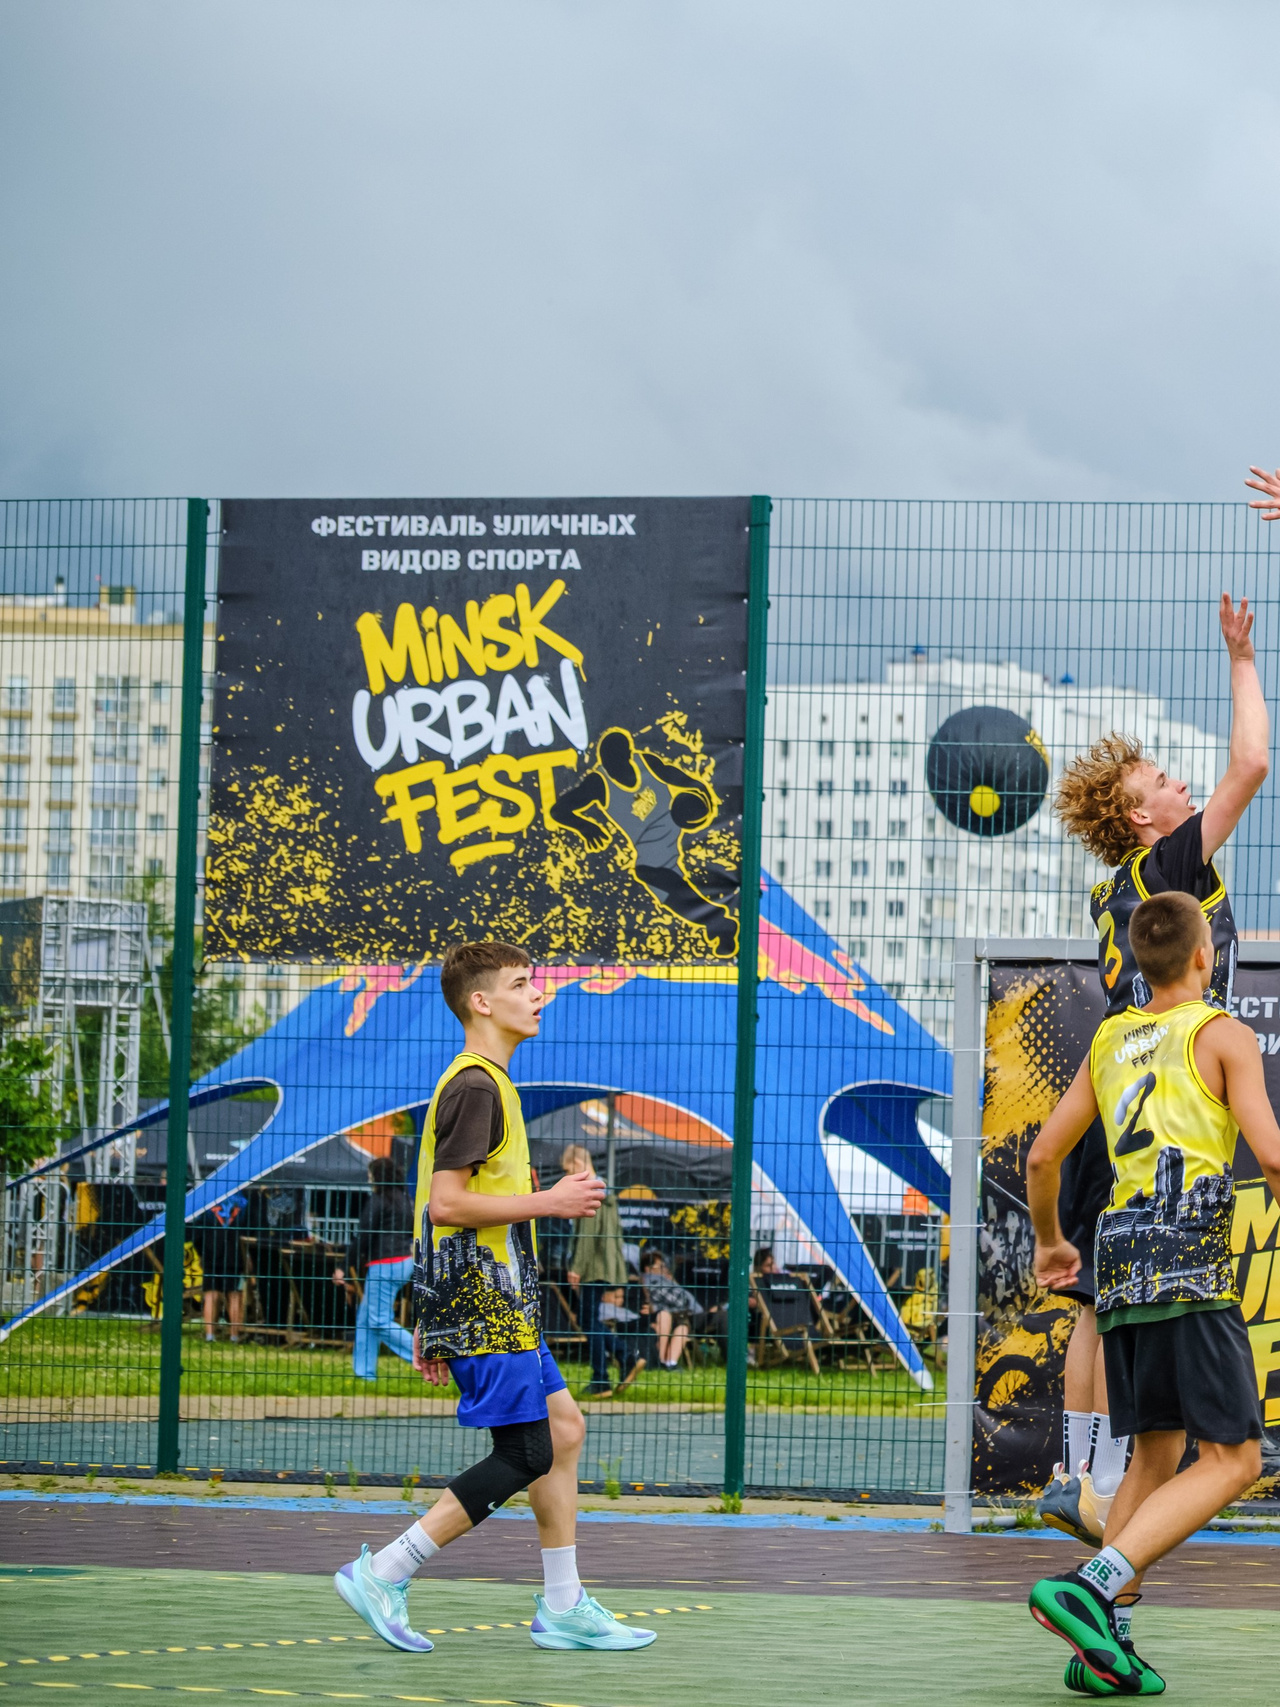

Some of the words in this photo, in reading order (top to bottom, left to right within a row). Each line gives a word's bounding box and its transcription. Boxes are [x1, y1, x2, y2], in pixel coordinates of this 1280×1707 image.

[311, 515, 487, 537] ФЕСТИВАЛЬ
[493, 514, 636, 536] УЛИЧНЫХ
[361, 549, 461, 574] ВИДОВ
[467, 549, 582, 571] СПОРТА
[352, 658, 589, 770] URBAN
[375, 747, 578, 854] FEST
[1114, 1071, 1156, 1158] 2
[1087, 1558, 1113, 1582] 96
